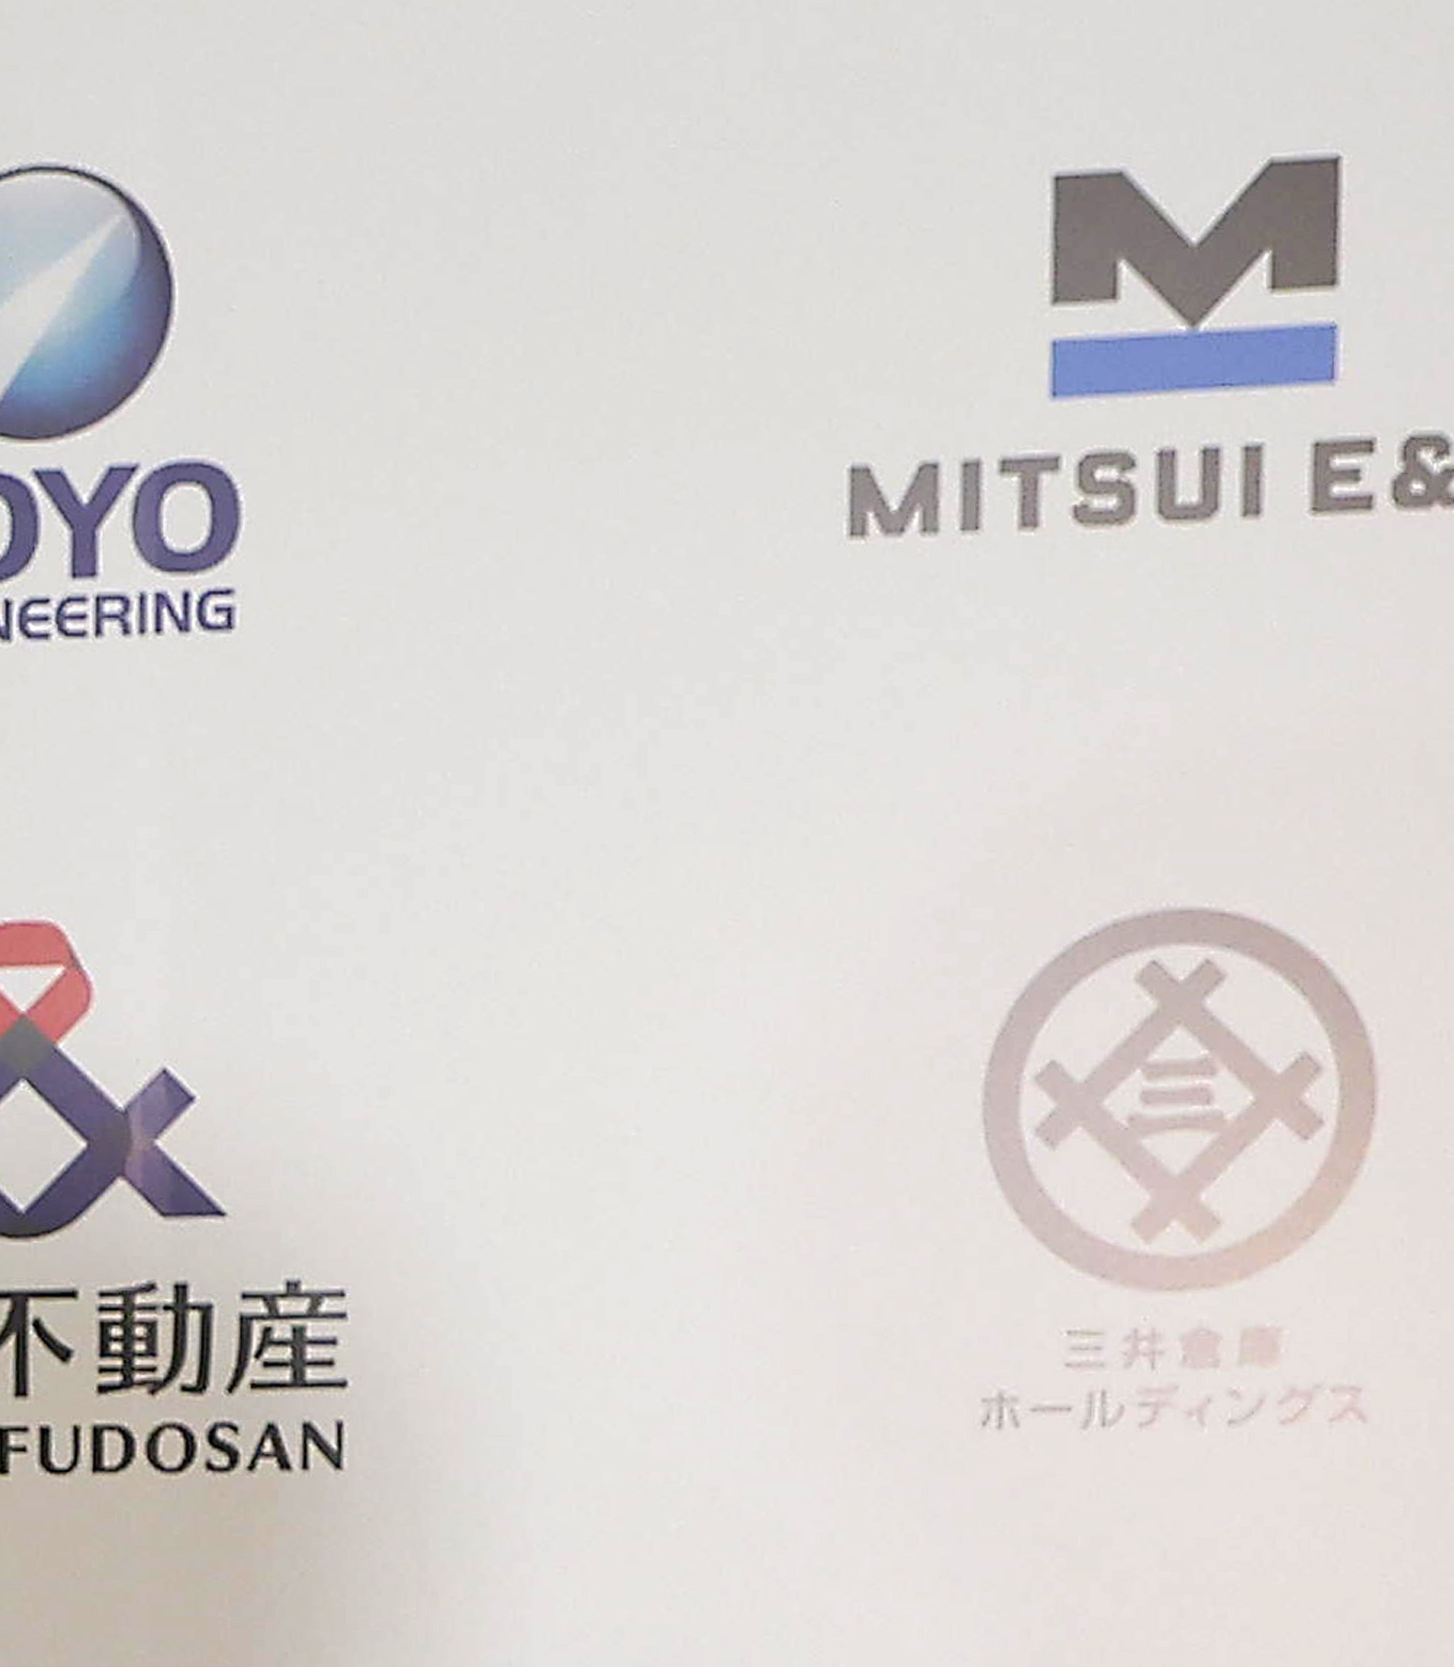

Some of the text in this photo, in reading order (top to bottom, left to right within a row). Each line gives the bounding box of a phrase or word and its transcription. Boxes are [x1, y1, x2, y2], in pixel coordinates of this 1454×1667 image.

[848, 442, 1264, 539] MITSUI
[979, 1383, 1369, 1431] ホールディングス
